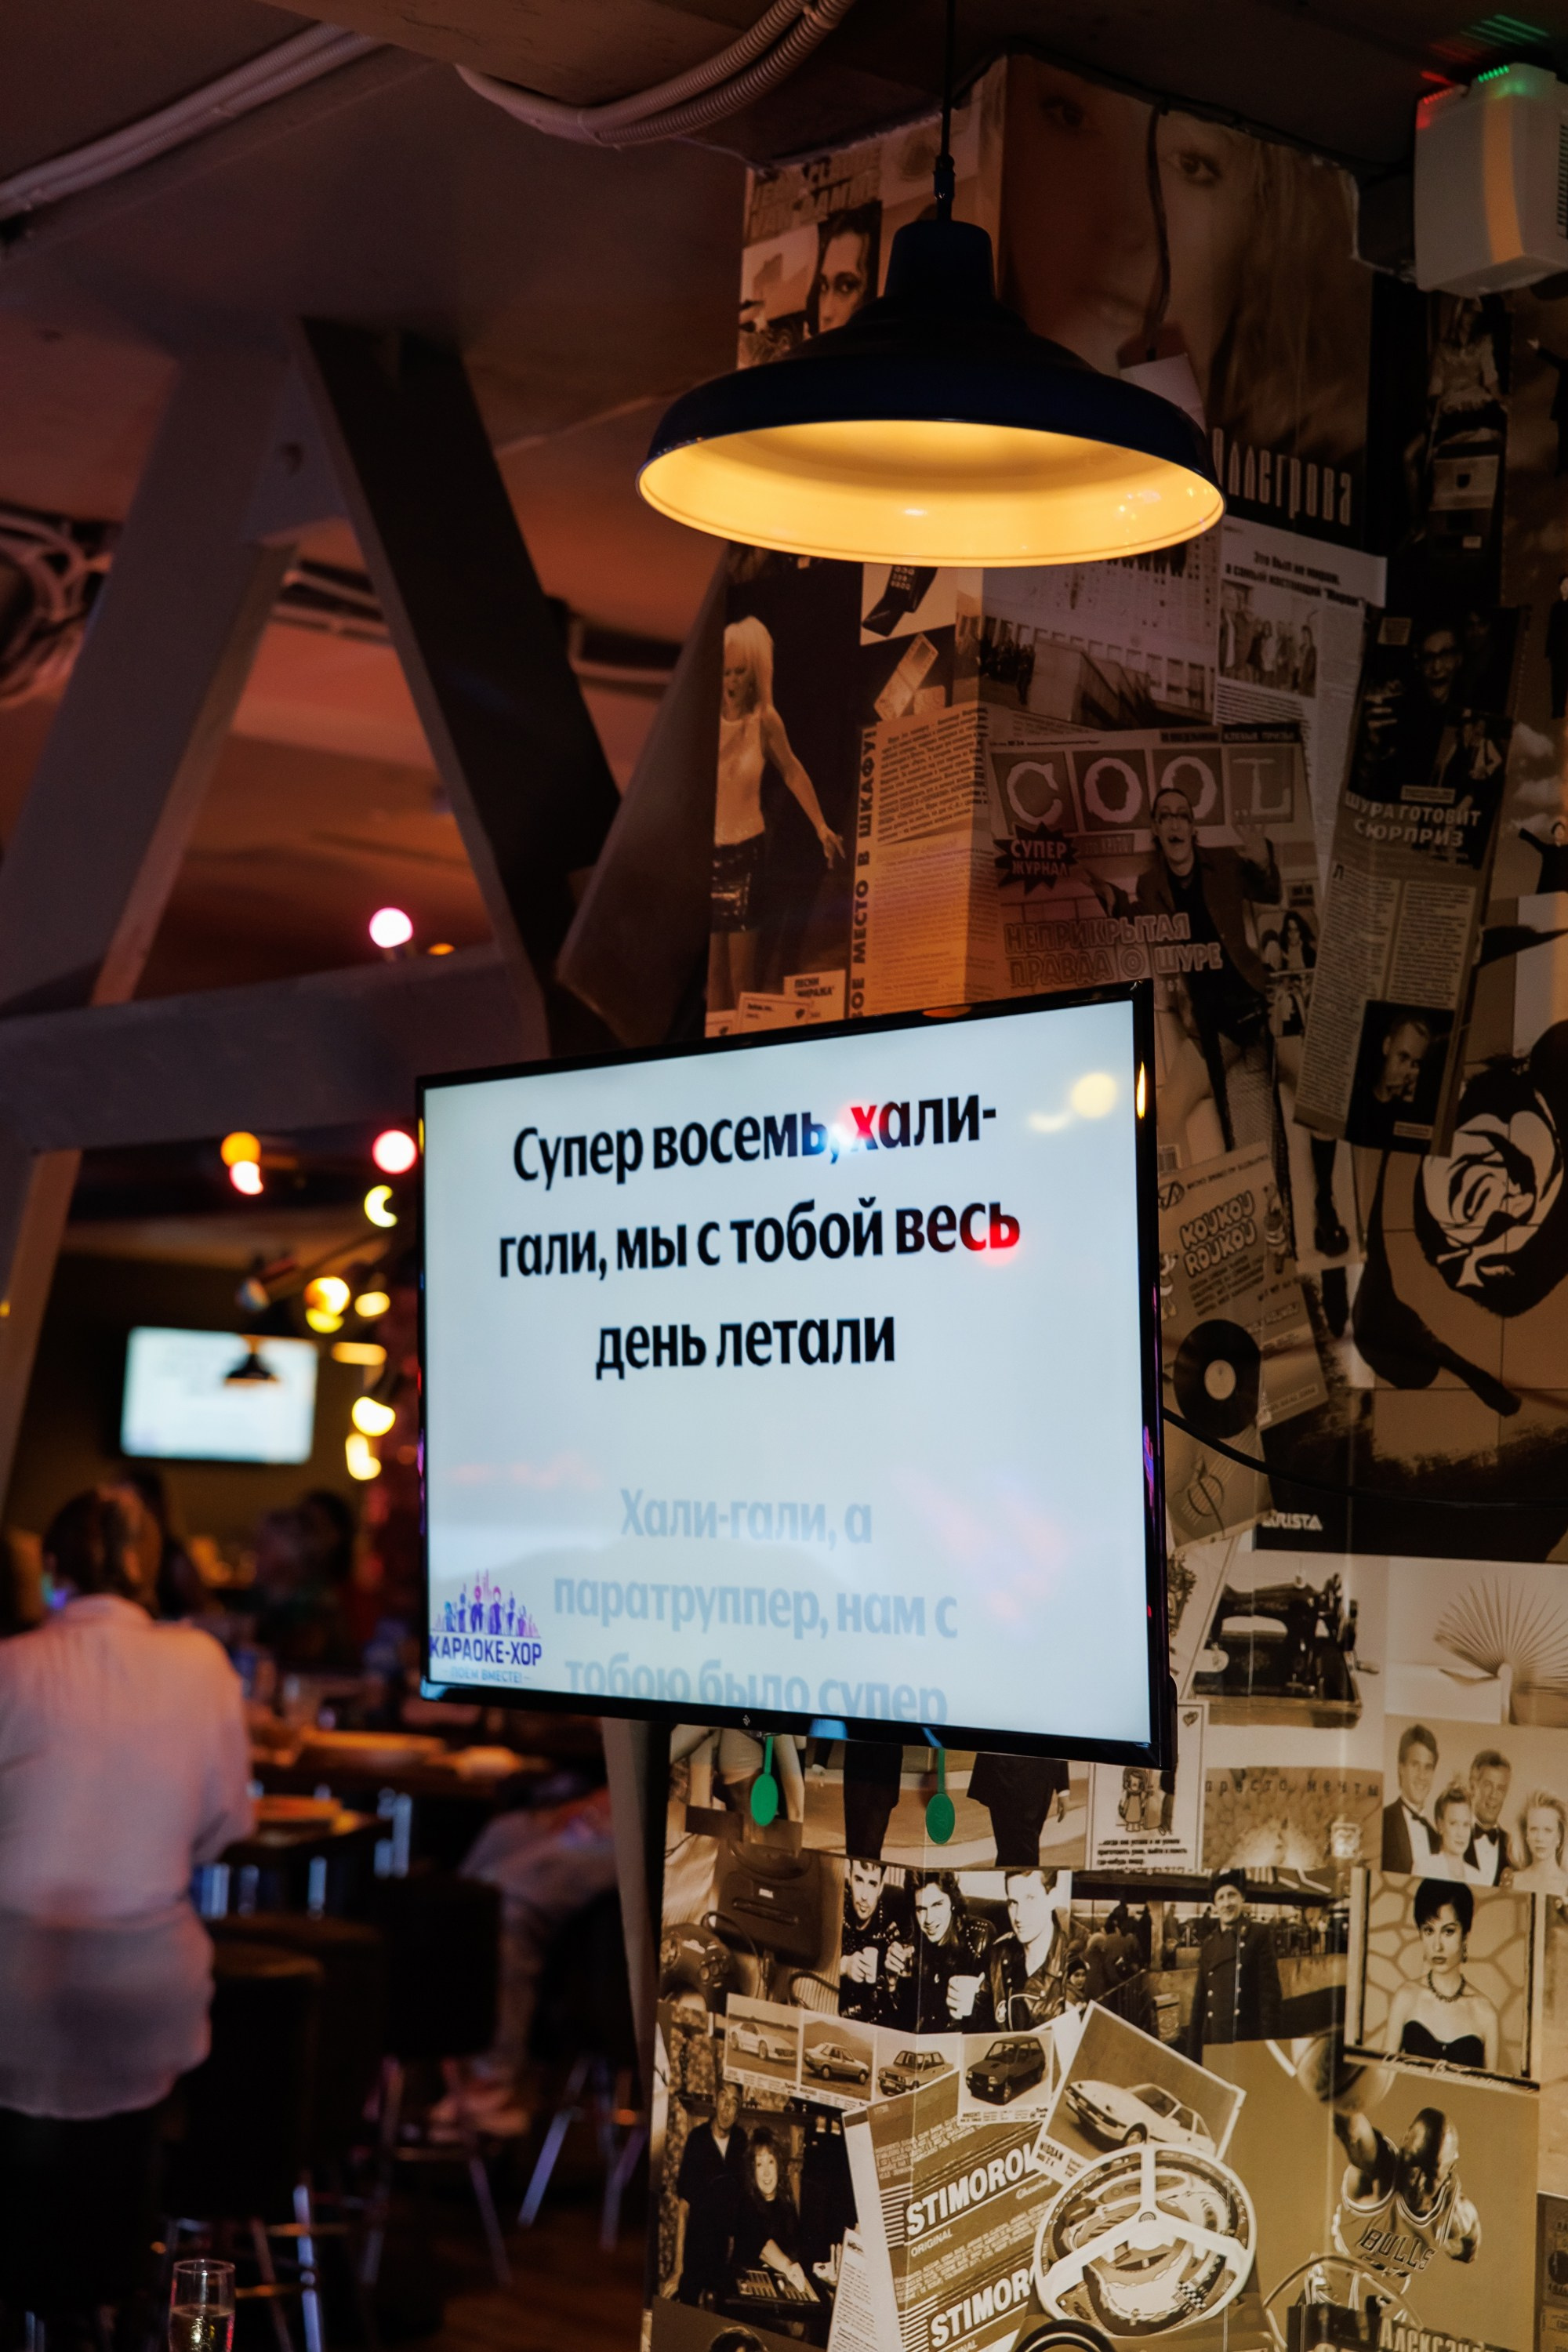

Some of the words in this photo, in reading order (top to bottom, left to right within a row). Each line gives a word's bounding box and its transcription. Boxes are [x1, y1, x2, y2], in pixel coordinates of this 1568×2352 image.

[1345, 791, 1395, 818] ШУРА
[1399, 804, 1482, 827] ГОТОВИТ
[1353, 818, 1464, 848] СЮРПРИЗ
[856, 850, 870, 867] В
[1011, 840, 1067, 858] СУПЕР
[1012, 861, 1070, 877] ЖУРНАЛ
[853, 879, 869, 964] МЕСТО
[1004, 912, 1191, 954] НЕПРИКРЫТАЯ
[1007, 948, 1113, 988] ПРАВДА
[1120, 946, 1145, 978] О
[1154, 942, 1224, 975] ШУРЕ
[514, 1127, 643, 1191] Супер
[652, 1112, 840, 1165] восемь,
[850, 1094, 996, 1151] хали-
[499, 1231, 608, 1280] гали,
[617, 1223, 687, 1270] мы
[698, 1221, 720, 1265] с
[730, 1196, 884, 1264] тобой
[895, 1201, 1020, 1254] весь
[1179, 1189, 1256, 1250] KOUKOU
[1184, 1218, 1258, 1279] ROUKOU
[596, 1323, 706, 1381] день
[717, 1316, 895, 1367] летали
[619, 1488, 837, 1550] Хали-гали,
[844, 1503, 872, 1544] а
[554, 1577, 829, 1639] паратруппер,
[837, 1592, 926, 1638] нам
[934, 1596, 958, 1639] с
[428, 1634, 543, 1667] КАРАОКЕ-ХОР
[565, 1652, 691, 1704] тобою
[699, 1658, 811, 1713] было
[818, 1675, 949, 1725] супер
[911, 2228, 953, 2258] ORIGINAL
[1358, 2227, 1438, 2271] BULLS
[931, 2263, 1034, 2347] STIMOR
